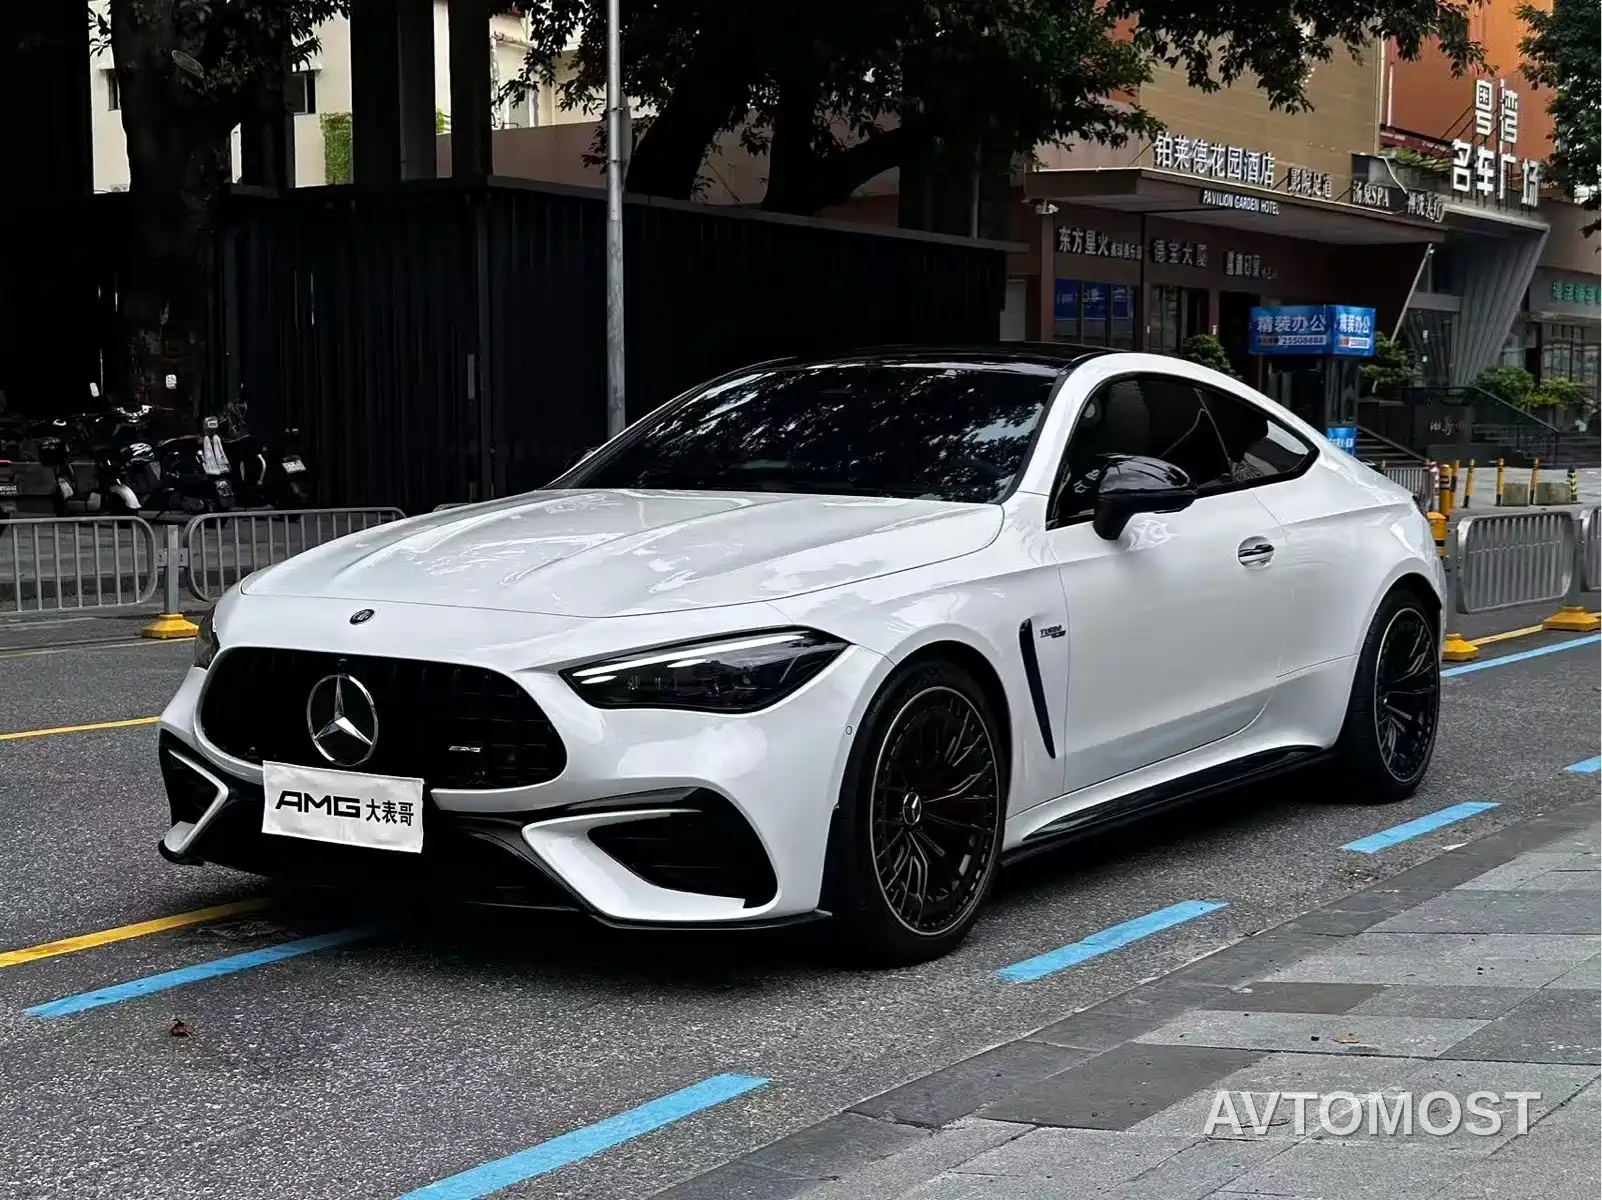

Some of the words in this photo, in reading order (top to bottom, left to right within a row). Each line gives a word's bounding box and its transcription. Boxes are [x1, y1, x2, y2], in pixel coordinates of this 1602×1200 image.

[1475, 79, 1519, 144] 粤湾
[1154, 132, 1276, 186] 铂莱德花园酒店
[1452, 139, 1541, 207] 名车广场
[1202, 190, 1233, 208] PAVILION
[1234, 195, 1260, 212] GARDEN
[1260, 201, 1280, 215] HOTEL
[1058, 226, 1109, 257] 东方星火
[1257, 315, 1326, 333] 精装办公
[1339, 314, 1370, 333] 精装办公
[275, 790, 361, 819] AMG
[365, 798, 414, 827] 大表哥
